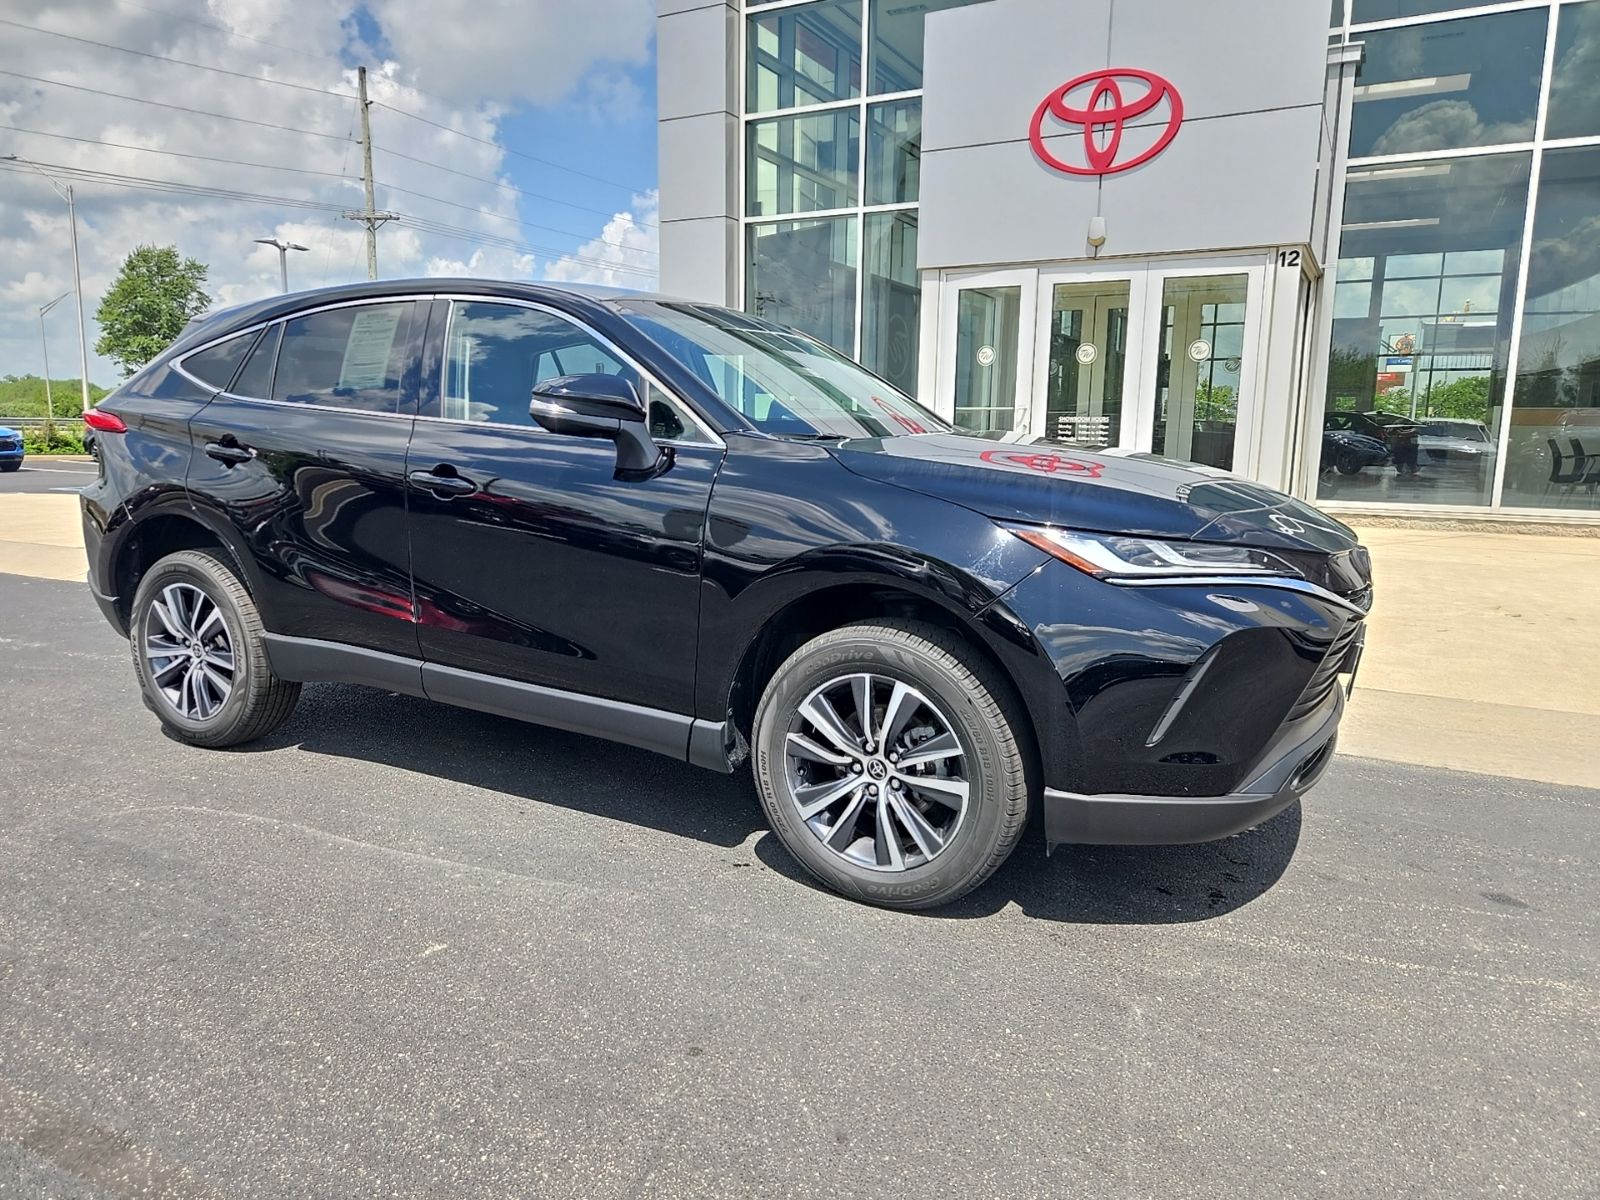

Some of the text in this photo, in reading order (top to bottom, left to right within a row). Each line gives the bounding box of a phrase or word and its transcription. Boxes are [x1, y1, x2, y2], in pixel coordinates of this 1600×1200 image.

[1279, 250, 1300, 267] 12
[806, 649, 874, 674] GeoDrive
[867, 877, 940, 897] GeoDrive
